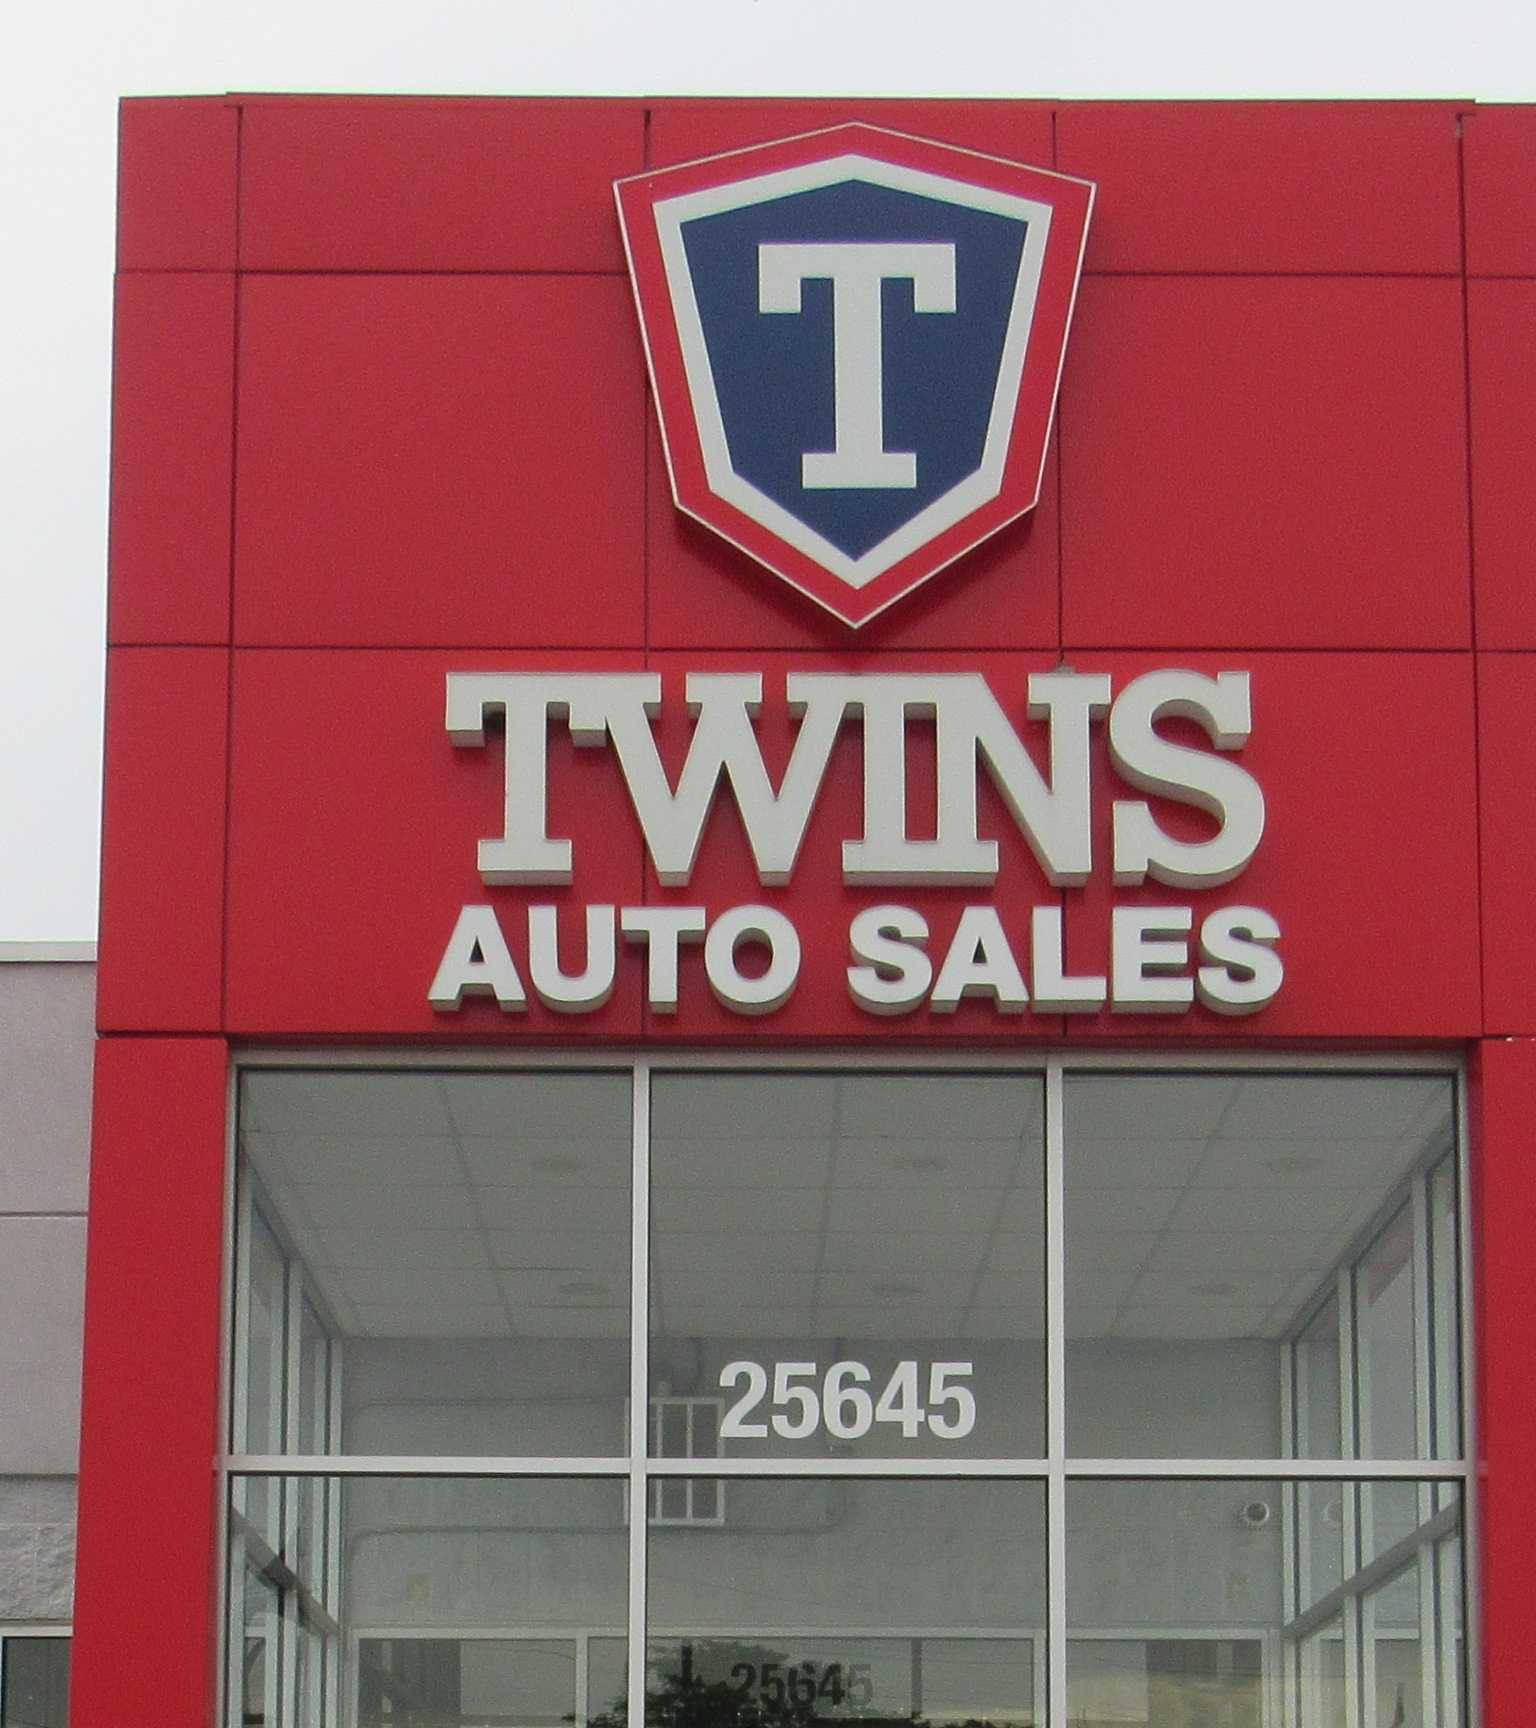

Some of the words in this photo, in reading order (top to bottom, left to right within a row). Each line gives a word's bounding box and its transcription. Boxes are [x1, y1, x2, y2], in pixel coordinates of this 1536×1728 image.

[758, 242, 957, 489] T
[445, 668, 1266, 890] TWINS
[427, 904, 802, 1013] AUTO
[845, 904, 1285, 1014] SALES
[718, 1360, 977, 1440] 25645
